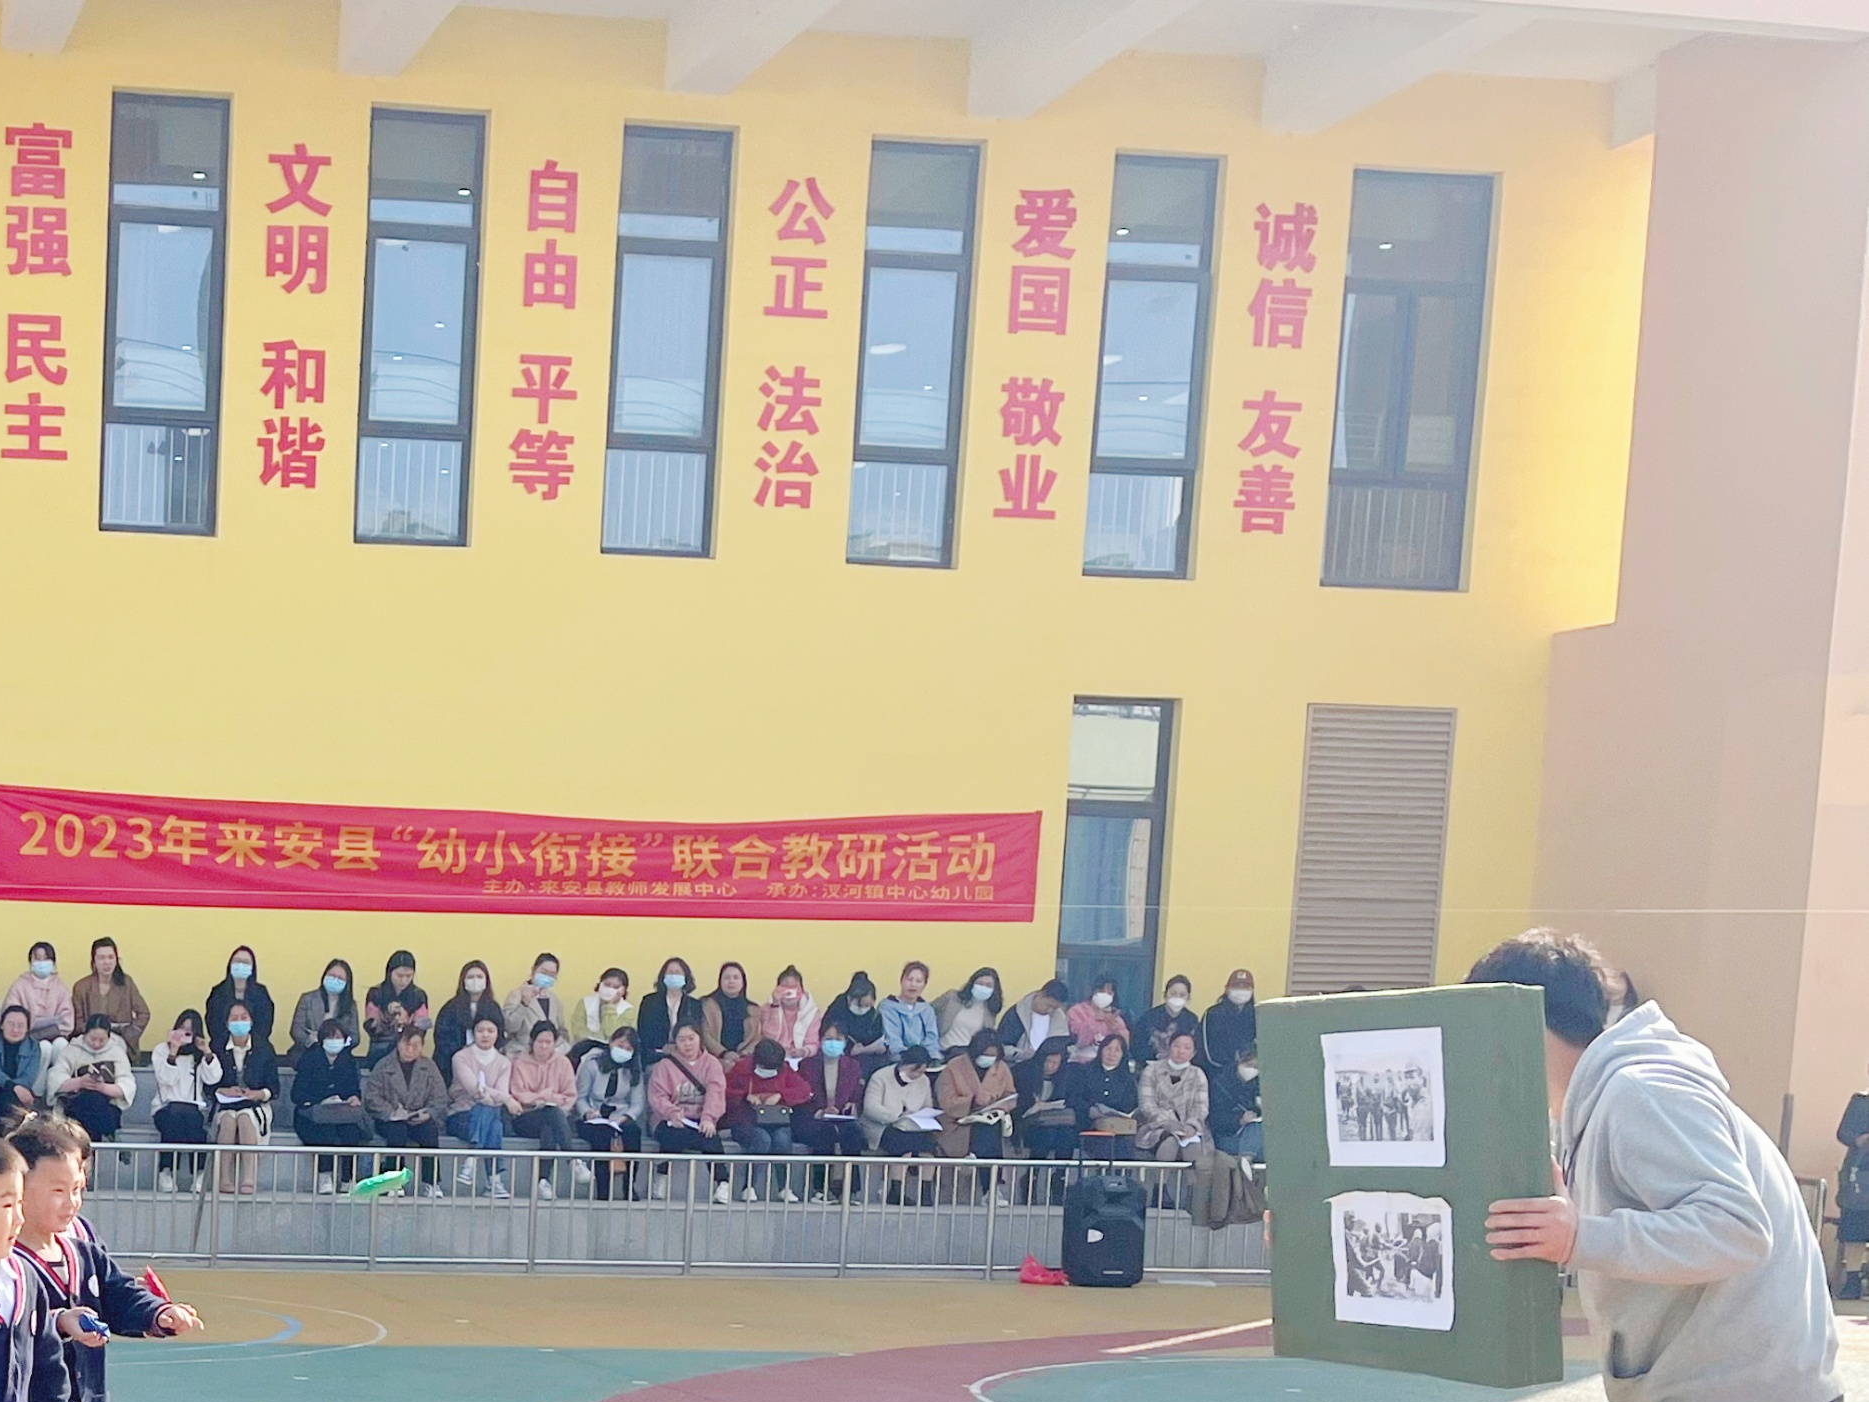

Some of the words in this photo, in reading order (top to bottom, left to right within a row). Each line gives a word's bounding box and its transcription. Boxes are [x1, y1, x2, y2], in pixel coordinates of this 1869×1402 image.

[4, 122, 73, 277] 富强
[265, 143, 332, 295] 文明
[523, 159, 580, 311] 自由
[763, 176, 835, 320] 公正
[1007, 187, 1078, 336] 爱国
[1248, 201, 1320, 350] 诚信
[0, 312, 68, 461] 民主
[256, 338, 326, 490] 和谐
[509, 353, 578, 501] 平等
[753, 365, 822, 509] 法治
[992, 376, 1066, 521] 敬业
[1233, 390, 1304, 534] 友善
